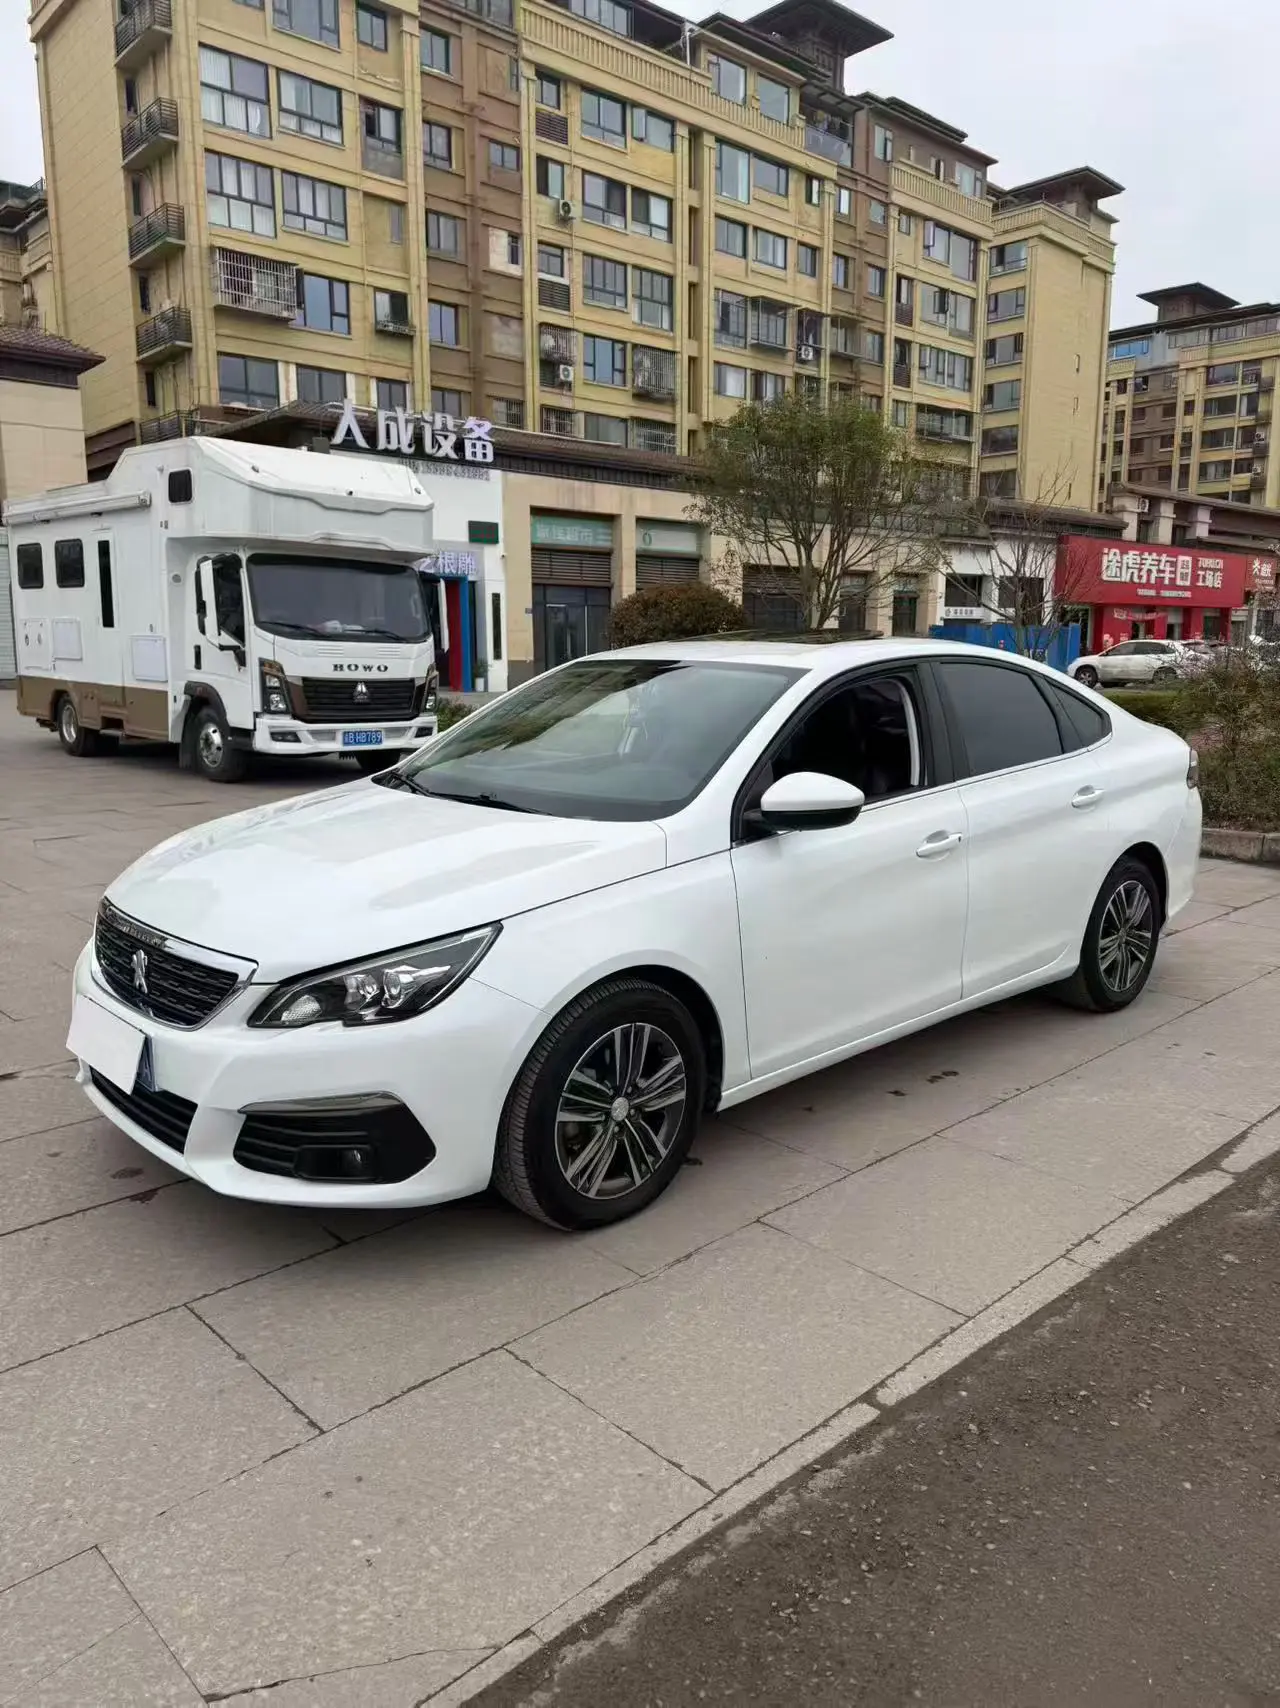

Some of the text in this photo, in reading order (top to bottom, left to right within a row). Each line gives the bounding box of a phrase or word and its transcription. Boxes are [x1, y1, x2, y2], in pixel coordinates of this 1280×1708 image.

[1101, 547, 1177, 585] 途虎养车
[1196, 570, 1223, 588] 工场店
[332, 663, 388, 672] HOWO
